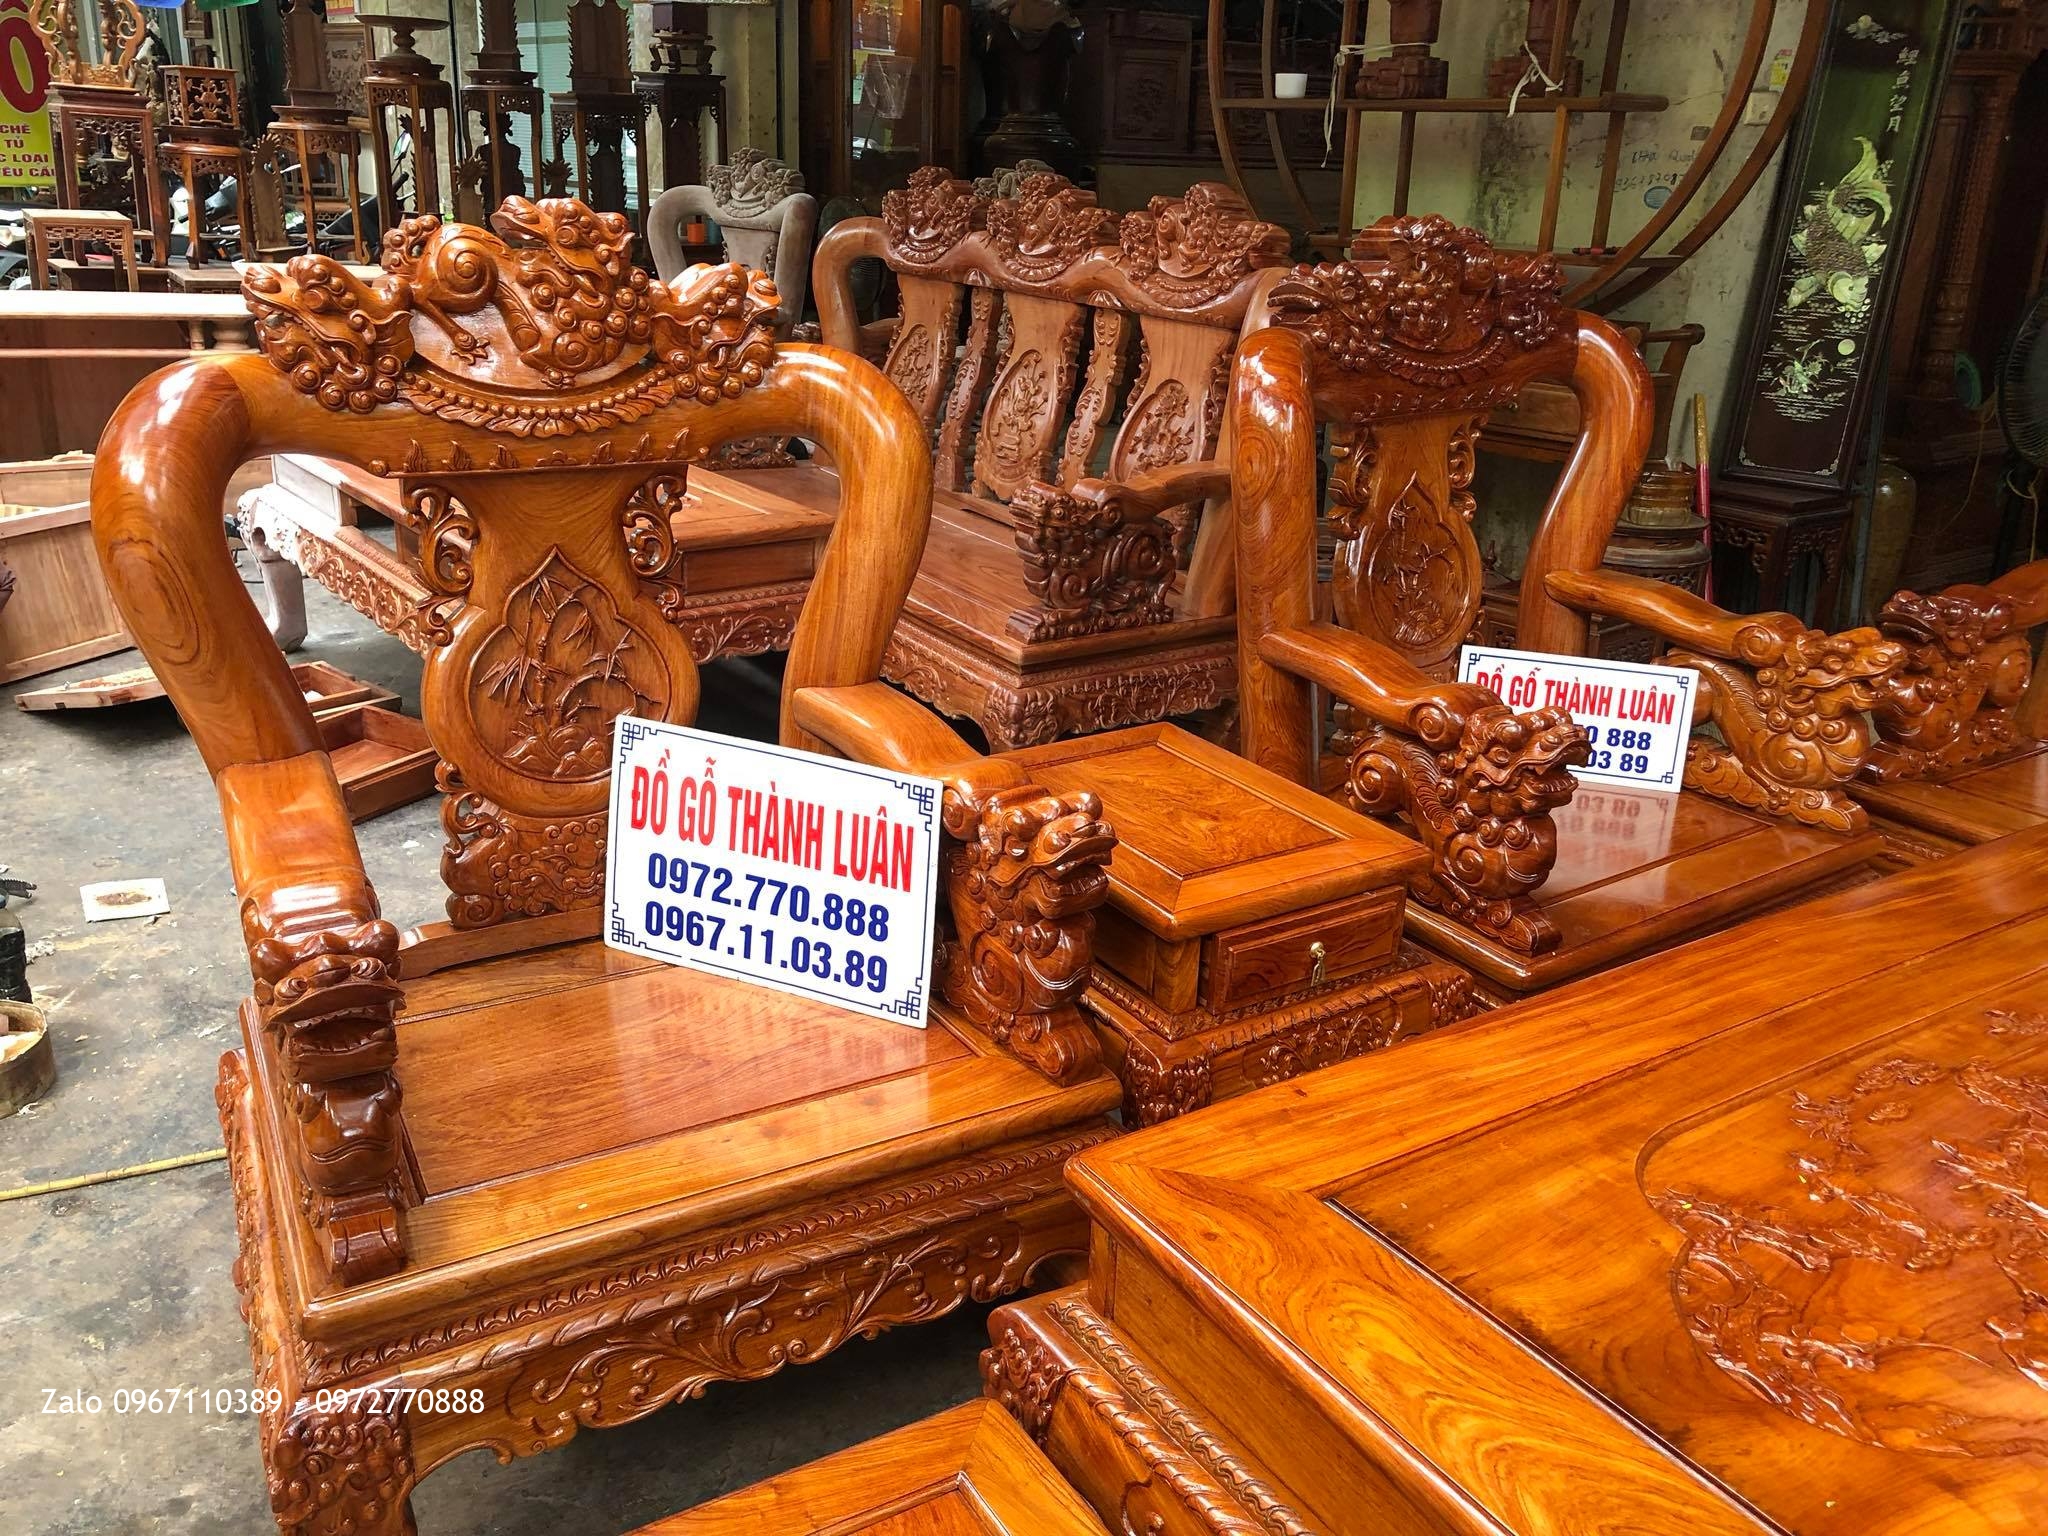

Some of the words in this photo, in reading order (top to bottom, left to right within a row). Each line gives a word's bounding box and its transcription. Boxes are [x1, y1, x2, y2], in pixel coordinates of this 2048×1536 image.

[12, 153, 49, 164] LOẠI
[1508, 667, 1541, 708] GỖ
[1544, 676, 1613, 717] THÀNH
[1617, 685, 1676, 725] LUÂN
[1606, 728, 1652, 751] 888
[1619, 753, 1648, 774] 89
[630, 748, 671, 836] ĐỒ
[678, 756, 717, 846] GỖ
[728, 781, 825, 871] THÀNH
[833, 805, 914, 893] LUÂN
[648, 852, 890, 942] 0972.770.888
[645, 901, 888, 993] 0967.11.03.89
